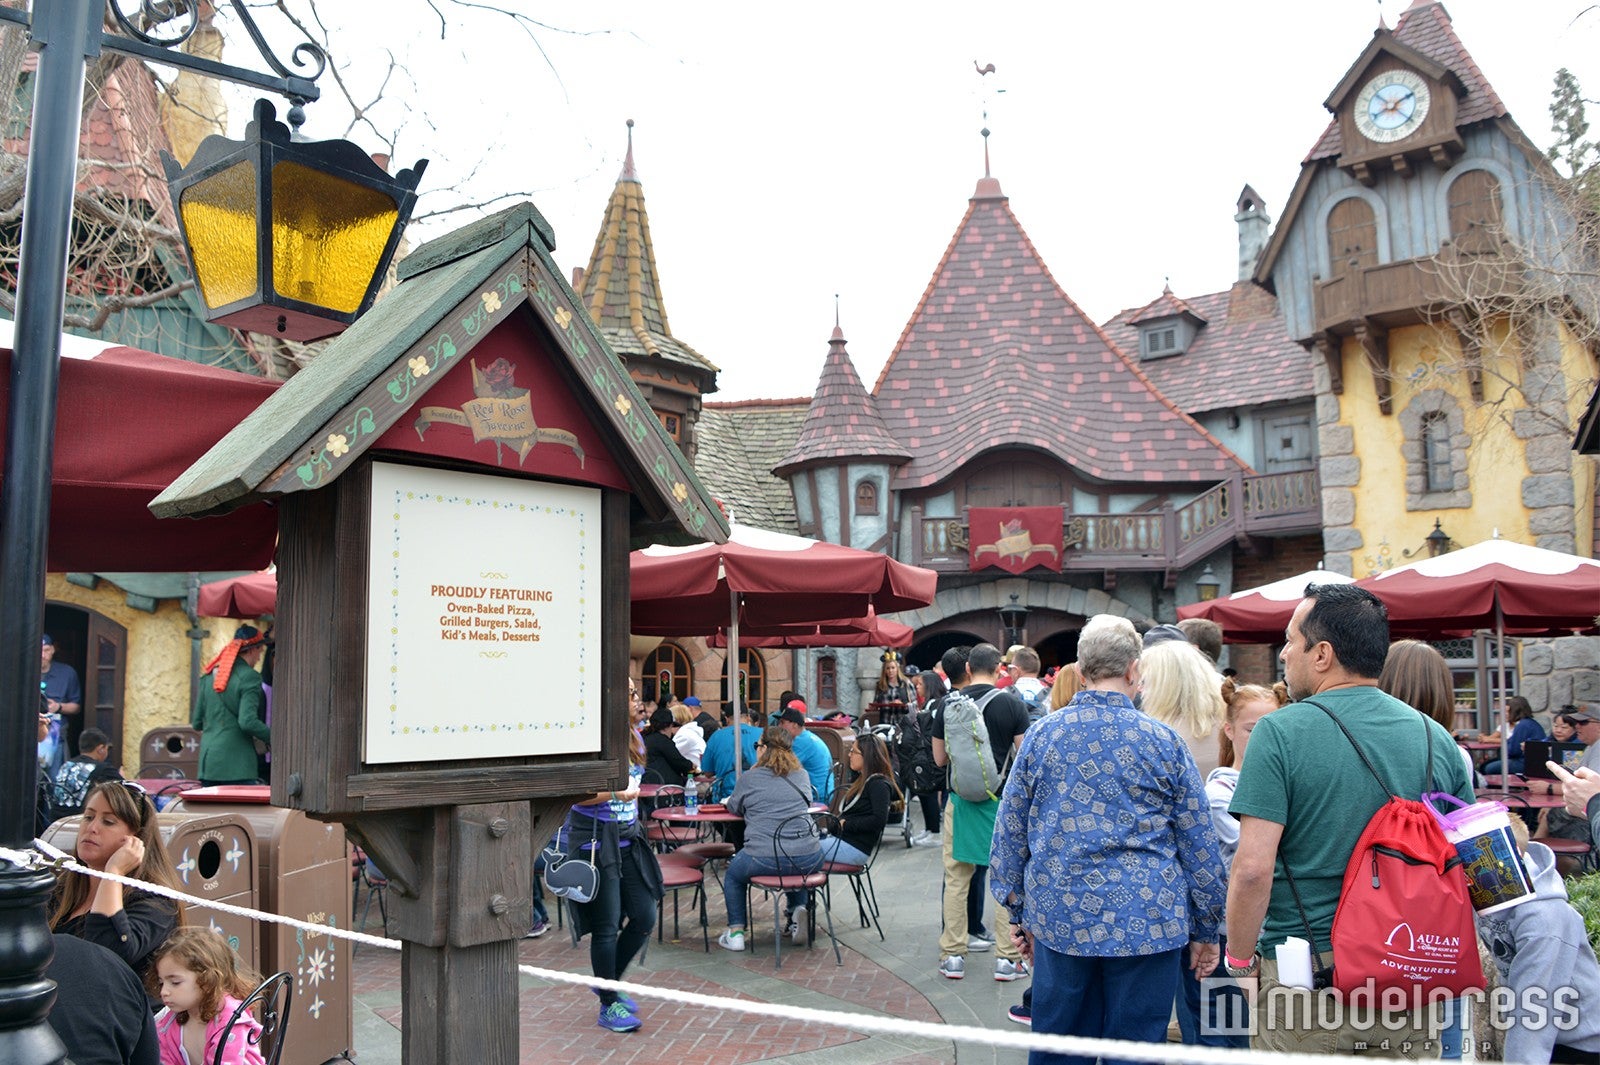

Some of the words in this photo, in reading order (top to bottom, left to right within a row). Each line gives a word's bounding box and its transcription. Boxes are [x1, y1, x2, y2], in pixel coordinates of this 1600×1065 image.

[472, 403, 494, 418] Red
[497, 402, 528, 419] Rose
[480, 418, 526, 432] Taverne
[431, 585, 487, 598] PROUDLY
[490, 588, 553, 601] FEATURING
[447, 602, 504, 614] Oven-Baked
[507, 605, 535, 616] Pizza,
[440, 616, 472, 626] Grilled
[474, 617, 512, 630] Burgers,
[514, 618, 541, 629] Salad,
[441, 630, 466, 640] Kid's
[468, 631, 500, 642] Meals,
[502, 631, 540, 642] Desserts
[197, 830, 225, 846] BOTTLES
